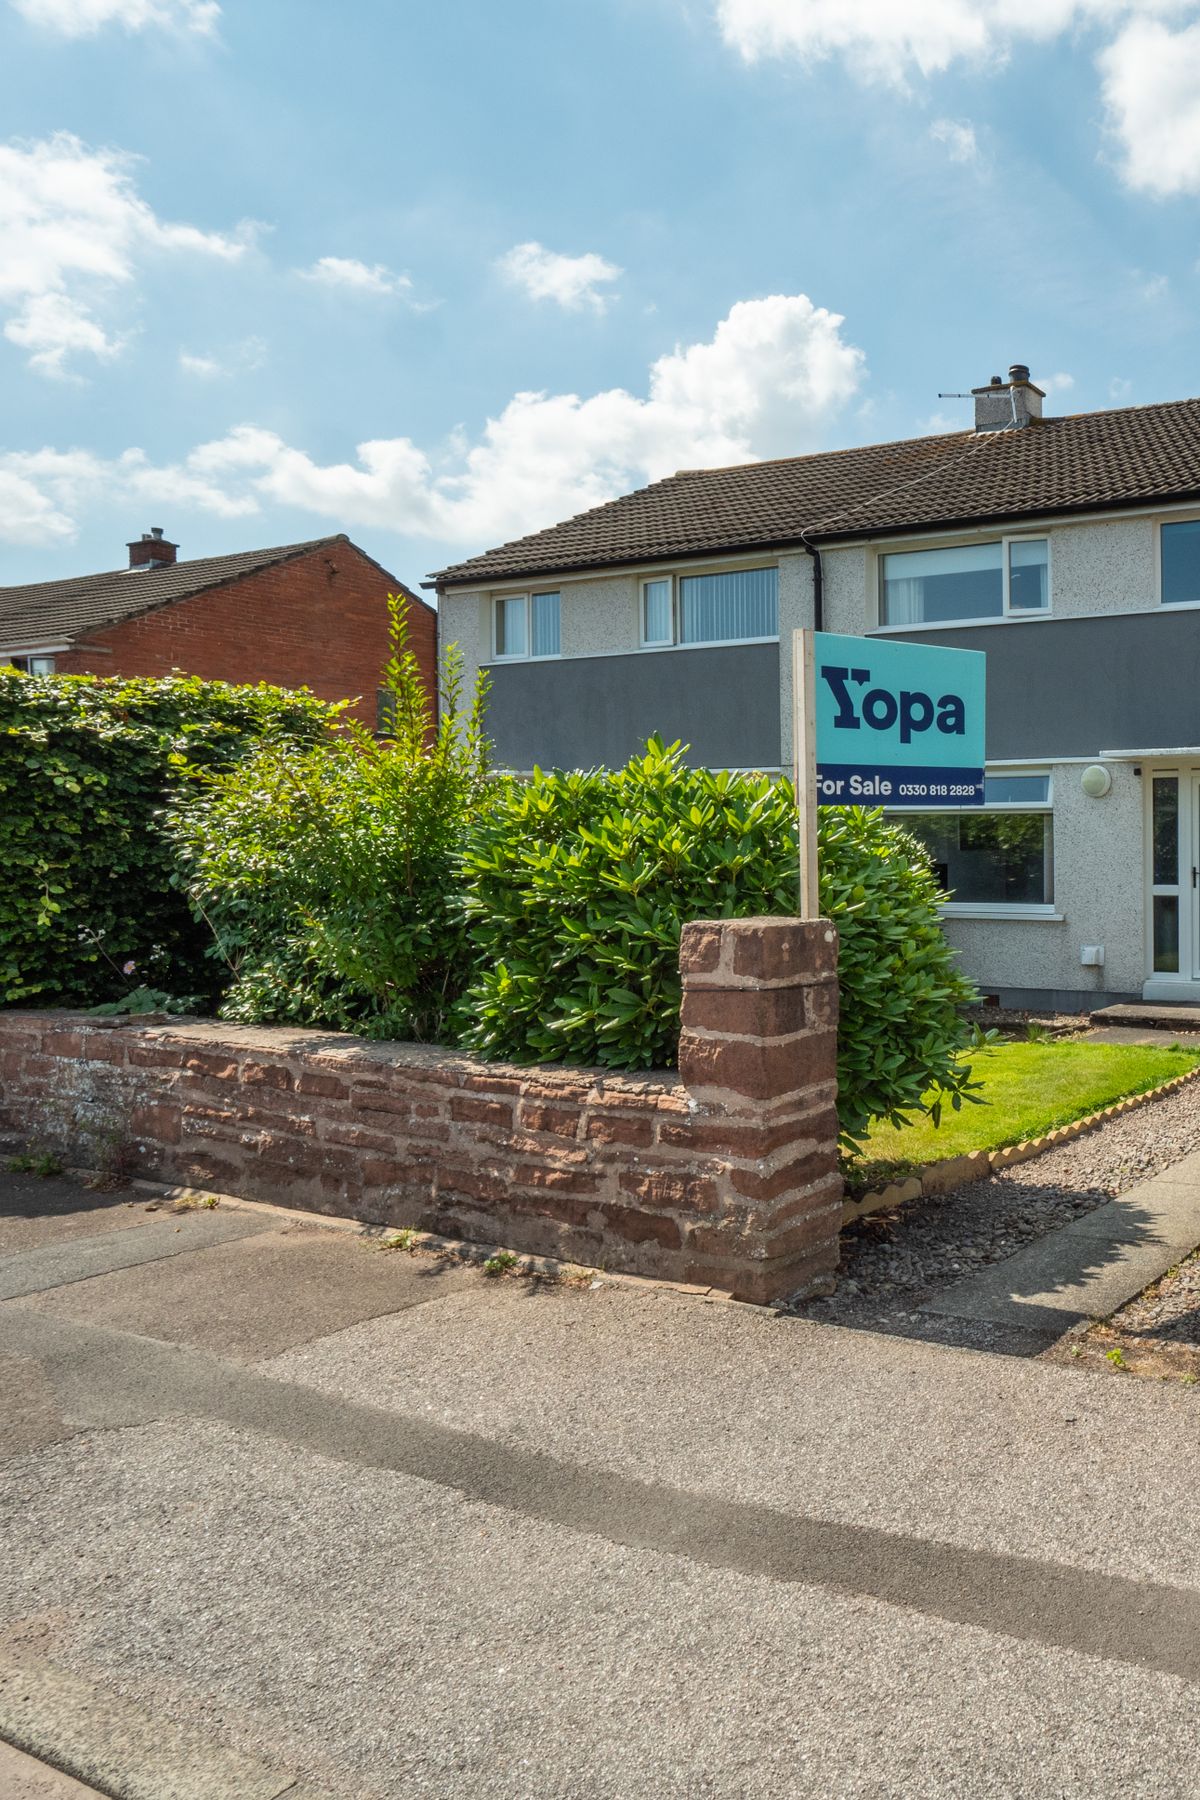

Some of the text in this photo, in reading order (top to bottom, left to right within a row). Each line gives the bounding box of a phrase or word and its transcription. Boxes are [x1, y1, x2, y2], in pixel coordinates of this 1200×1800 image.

[821, 666, 966, 744] Yopa
[849, 774, 892, 796] Sale
[899, 784, 975, 796] 0330 818 2828
